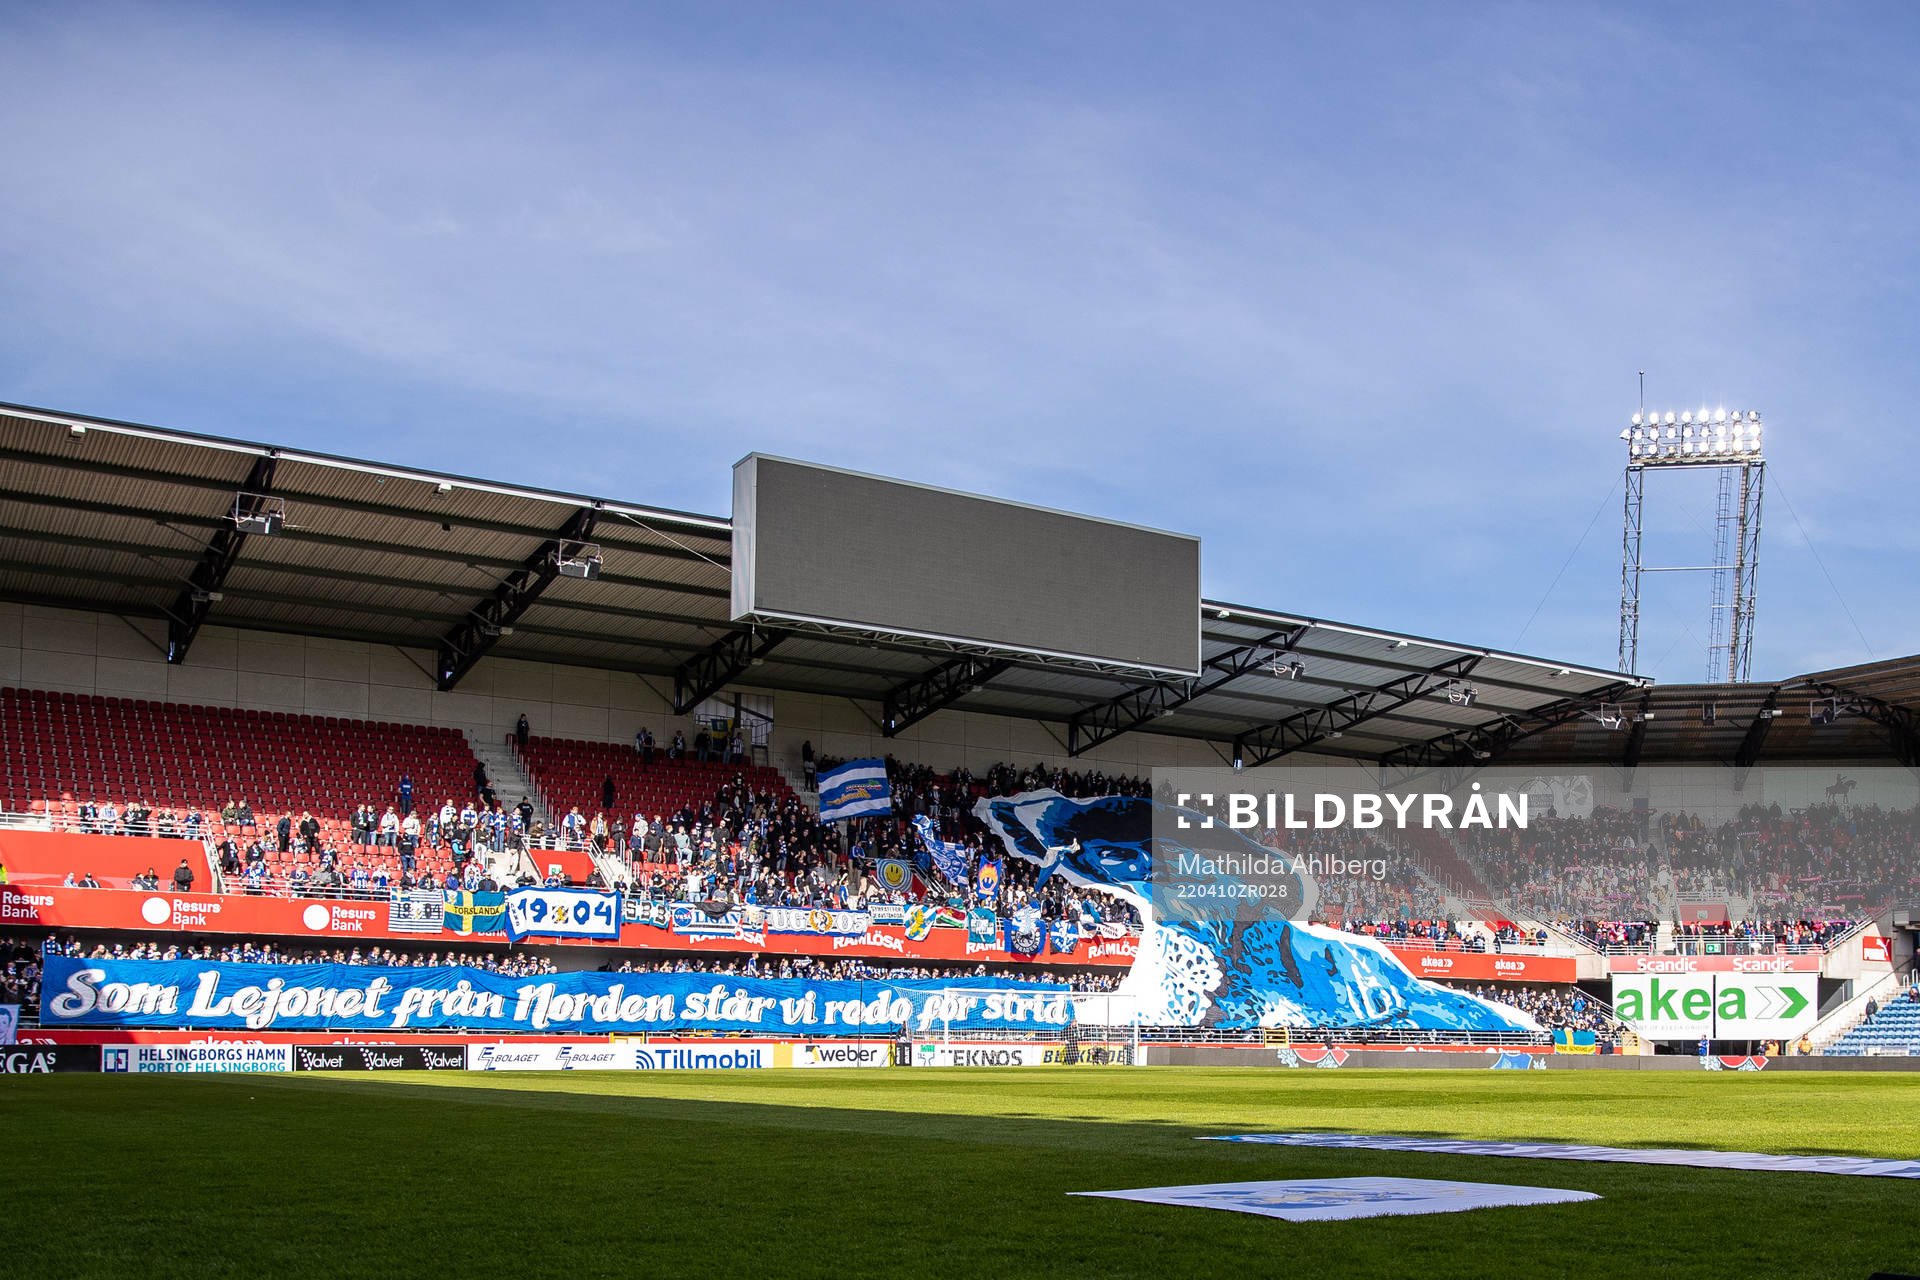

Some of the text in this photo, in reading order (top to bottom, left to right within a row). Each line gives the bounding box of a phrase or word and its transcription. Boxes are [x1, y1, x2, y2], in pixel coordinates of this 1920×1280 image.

[3, 891, 54, 906] Resurs
[173, 898, 221, 913] Resurs
[2, 905, 39, 919] Bank
[332, 905, 376, 920] Resurs
[454, 905, 499, 916] TORSLANDA
[172, 911, 206, 926] Bank
[331, 918, 363, 932] Bank
[833, 930, 903, 953] RAMLÖSA
[1088, 940, 1138, 959] RAMLÖS
[1637, 957, 1697, 972] Scandic
[1733, 957, 1793, 972] Scandic
[51, 968, 1069, 1033] Som Lejonet från Norden står vi redo för strid
[1615, 977, 1748, 1021] akea
[139, 1048, 286, 1061] HELSINGBORGS HAMN
[307, 1052, 343, 1068] Valvet
[369, 1052, 403, 1068] Valvet
[429, 1052, 462, 1068] Valvet
[655, 1049, 762, 1070] Tillmobil
[819, 1044, 878, 1063] weber
[138, 1062, 286, 1073] PORT OF HELSINGBORG
